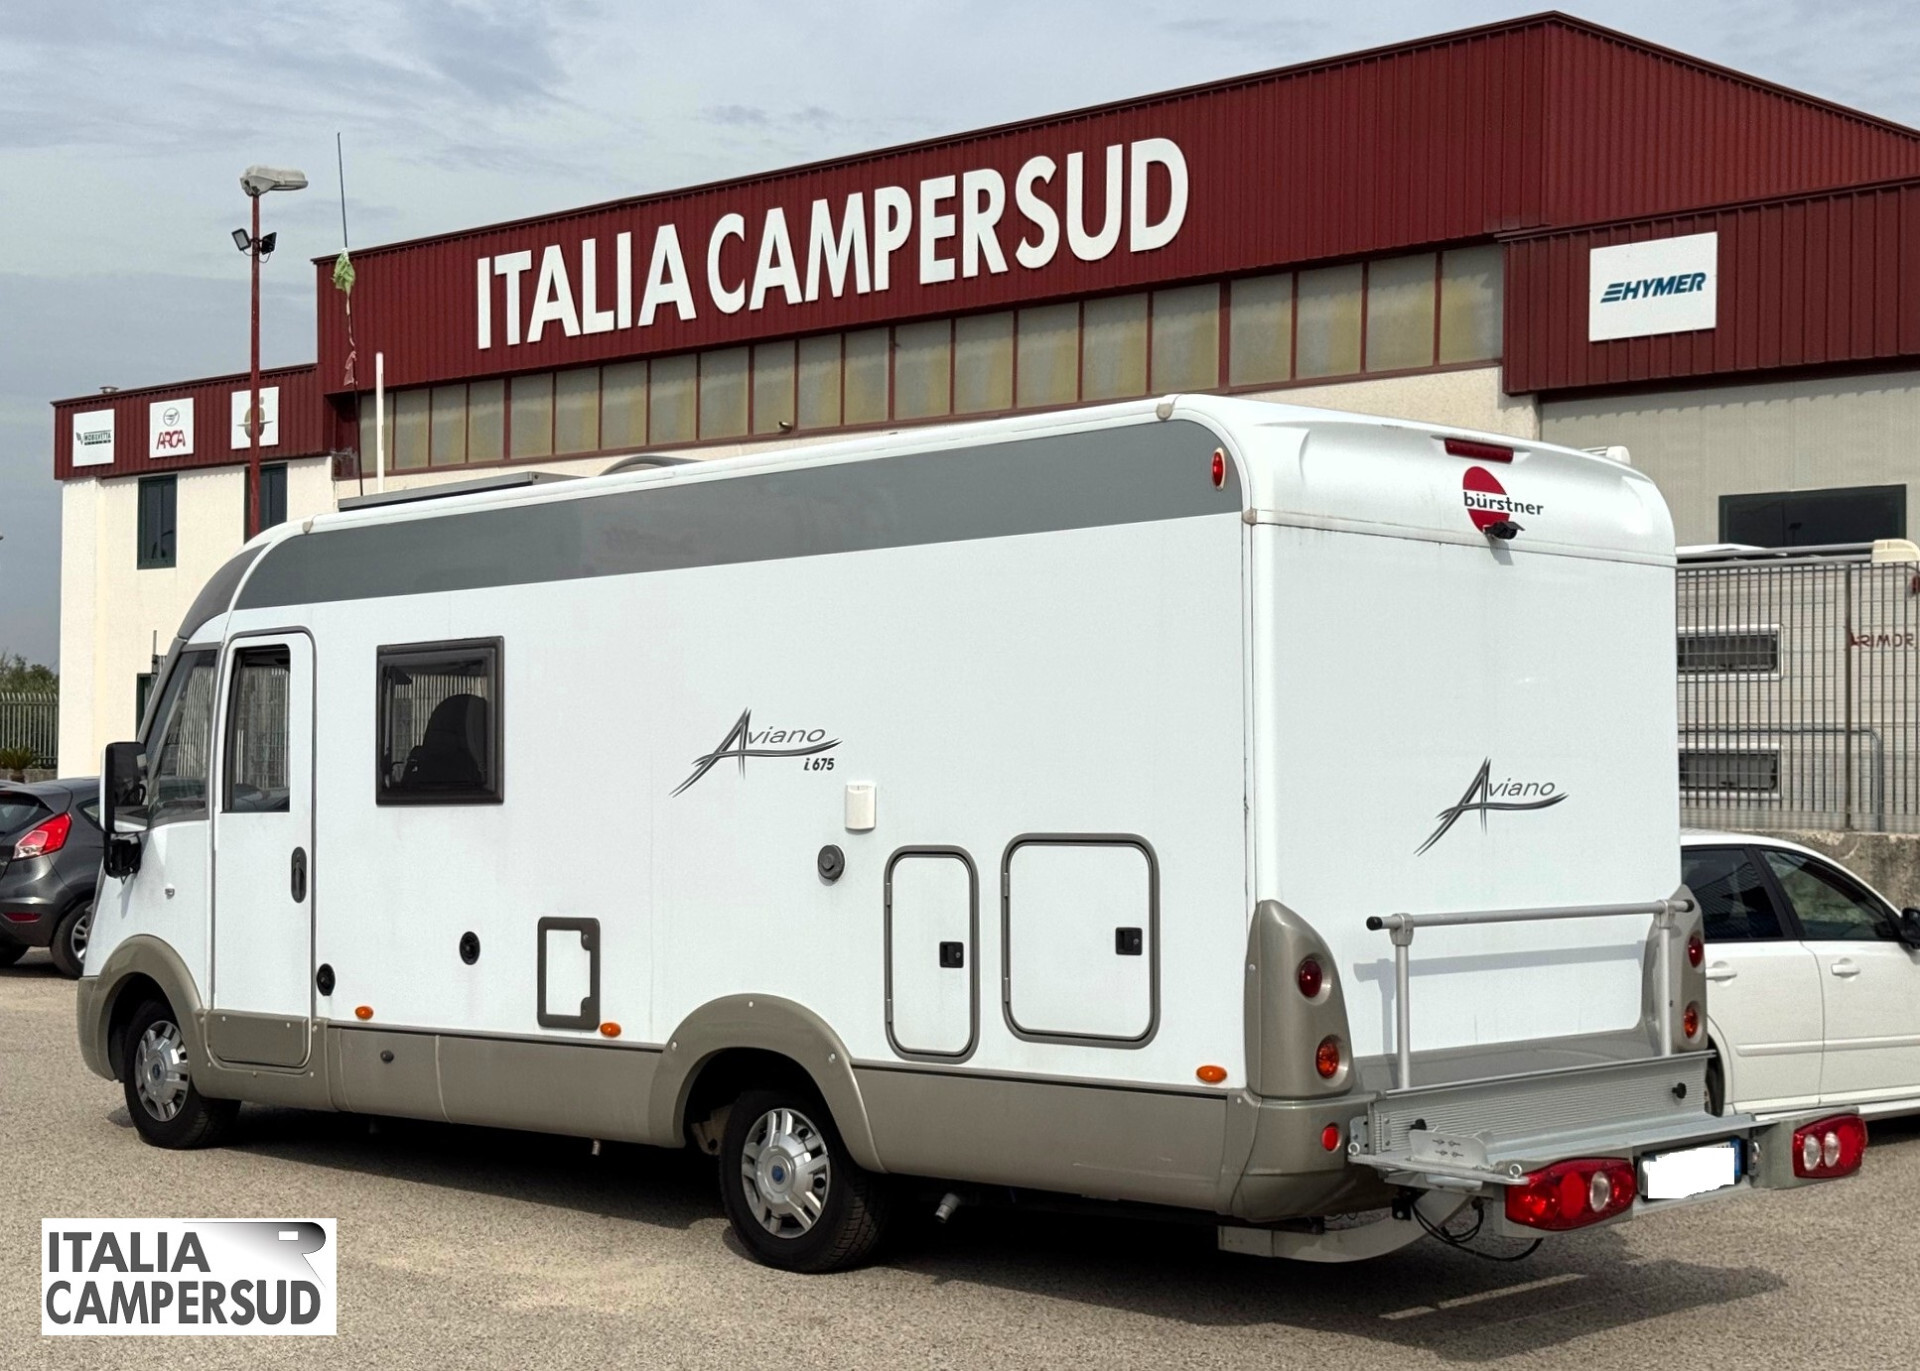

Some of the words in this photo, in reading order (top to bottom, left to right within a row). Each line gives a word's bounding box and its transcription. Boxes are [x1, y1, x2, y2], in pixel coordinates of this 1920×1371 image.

[478, 223, 697, 350] ITALIA
[707, 137, 1189, 315] CAMPERSUD
[1621, 271, 1707, 301] HYMER
[156, 430, 186, 450] ARCA
[1463, 491, 1544, 516] bürstner
[668, 706, 843, 798] Aviano
[1413, 756, 1570, 857] Aviano
